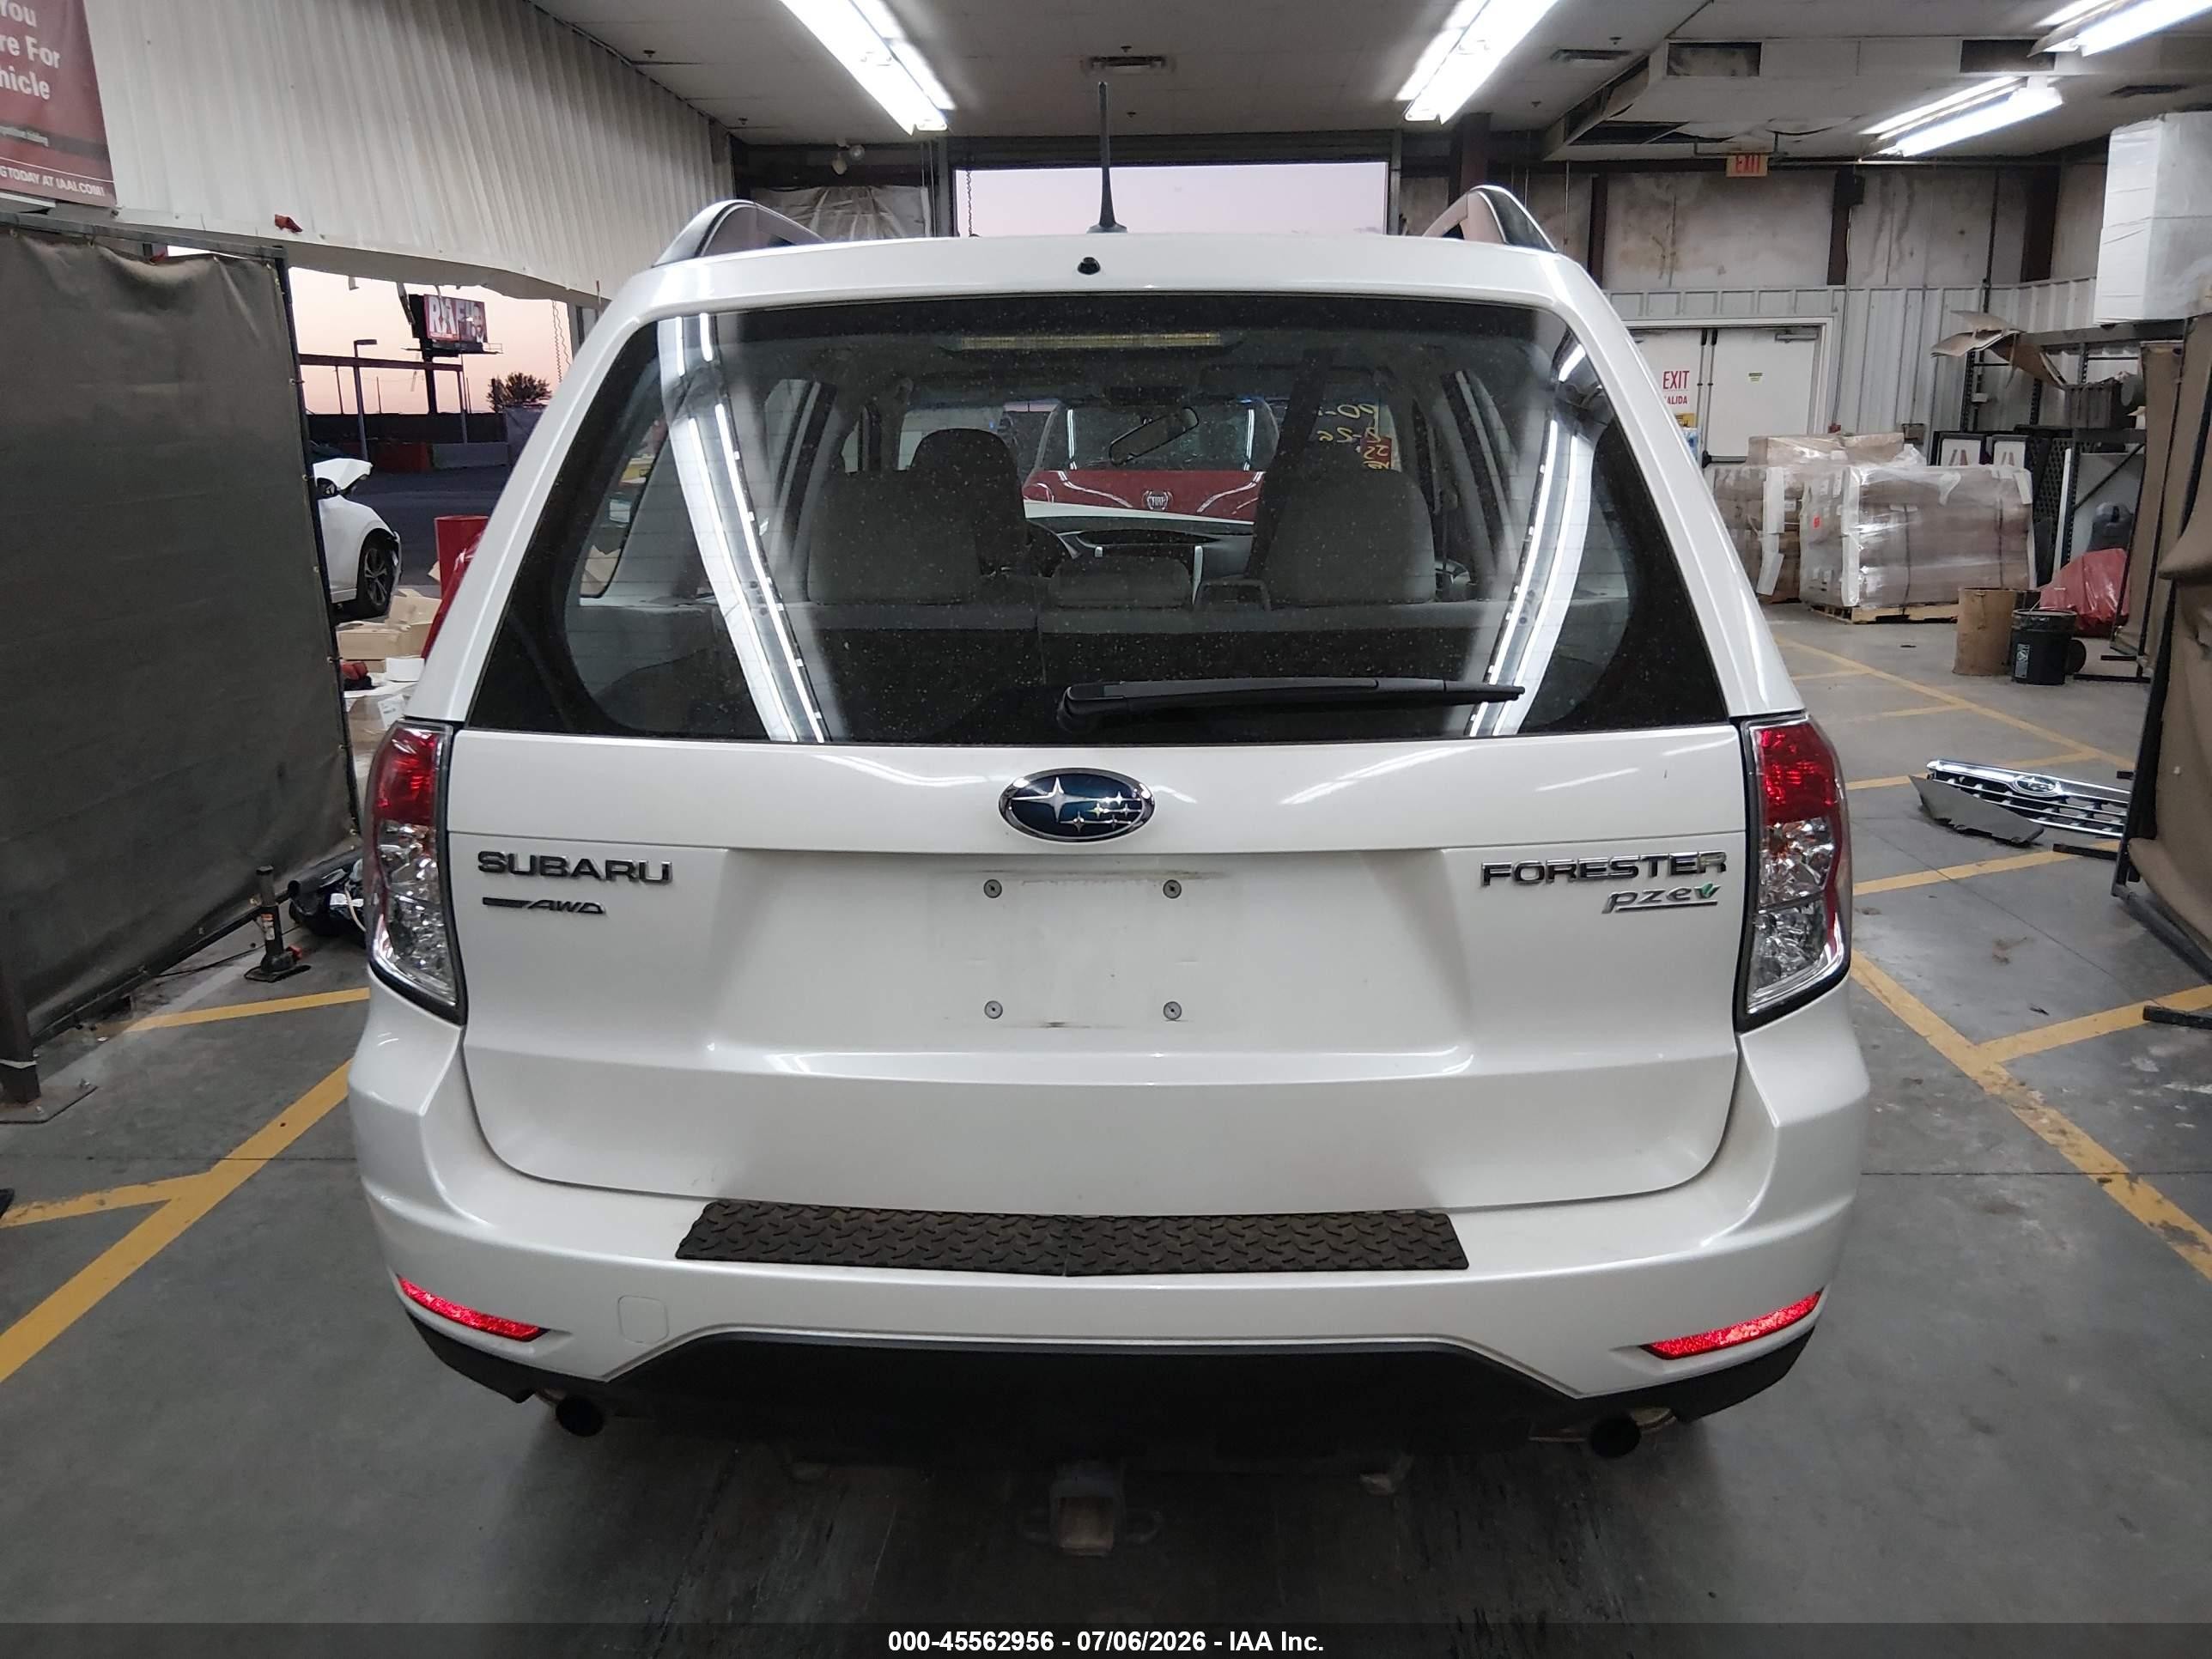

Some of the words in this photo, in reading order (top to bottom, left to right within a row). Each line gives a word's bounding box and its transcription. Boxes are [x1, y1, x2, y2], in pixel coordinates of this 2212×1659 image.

[25, 34, 61, 69] For
[42, 174, 54, 186] AT
[1662, 370, 1690, 390] EXIT
[1664, 395, 1688, 405] ALIDA
[477, 850, 672, 884] SUBARU
[1480, 850, 1728, 888] FORESTER
[527, 898, 605, 915] AWD
